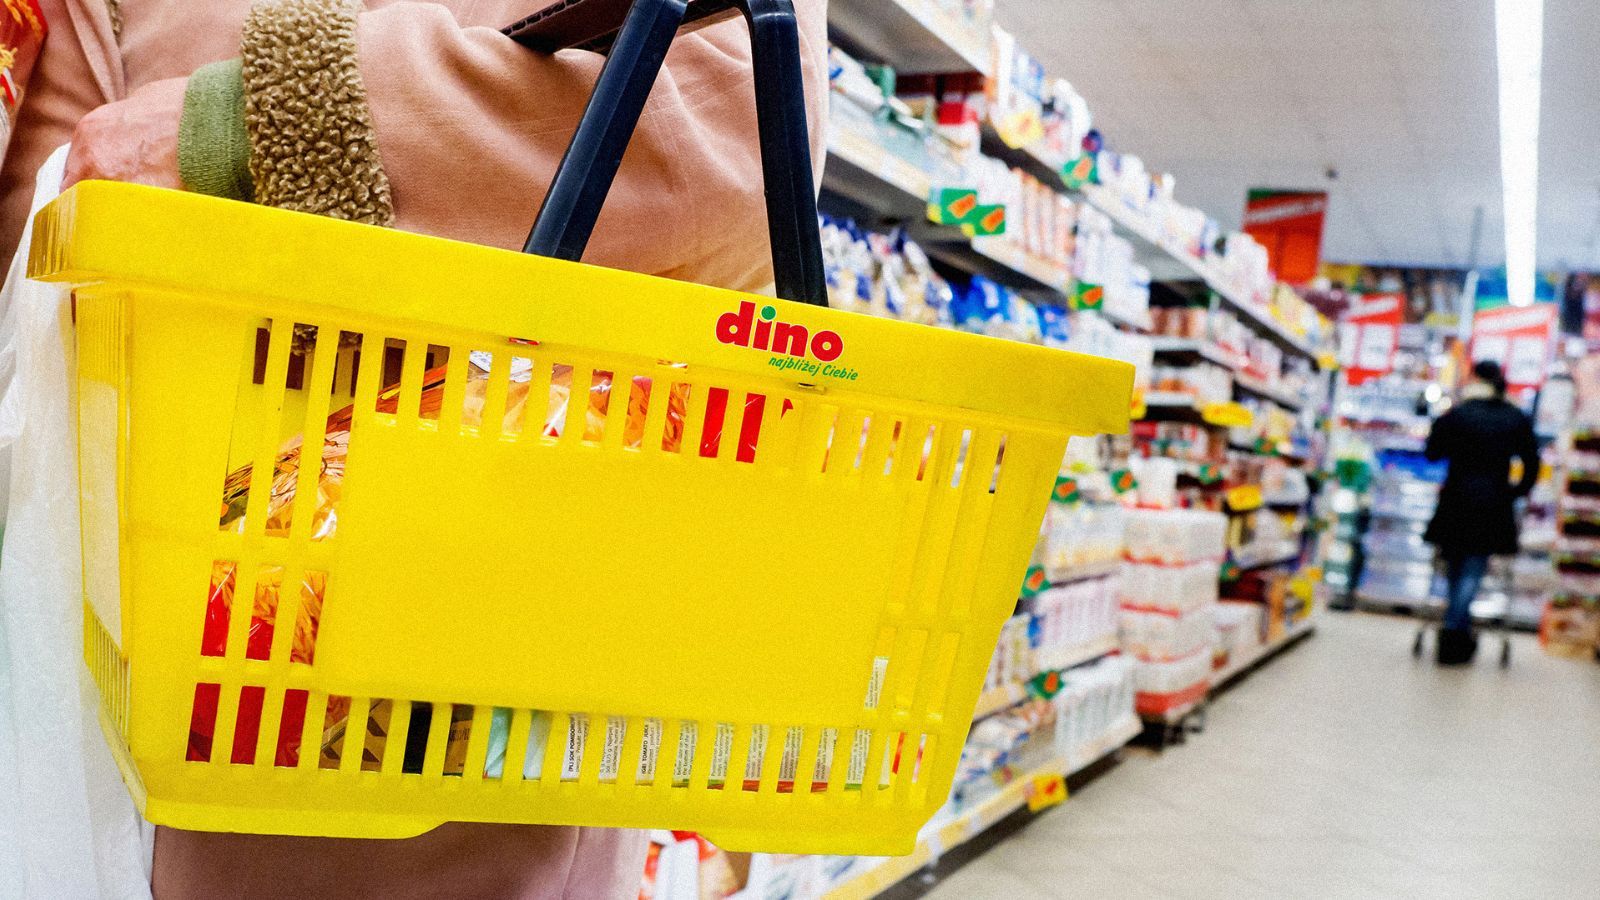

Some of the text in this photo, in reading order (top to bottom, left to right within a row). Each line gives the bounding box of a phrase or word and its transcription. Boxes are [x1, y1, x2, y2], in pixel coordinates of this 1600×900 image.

[715, 300, 844, 362] dino
[768, 356, 859, 381] najbliżej Ciebie
